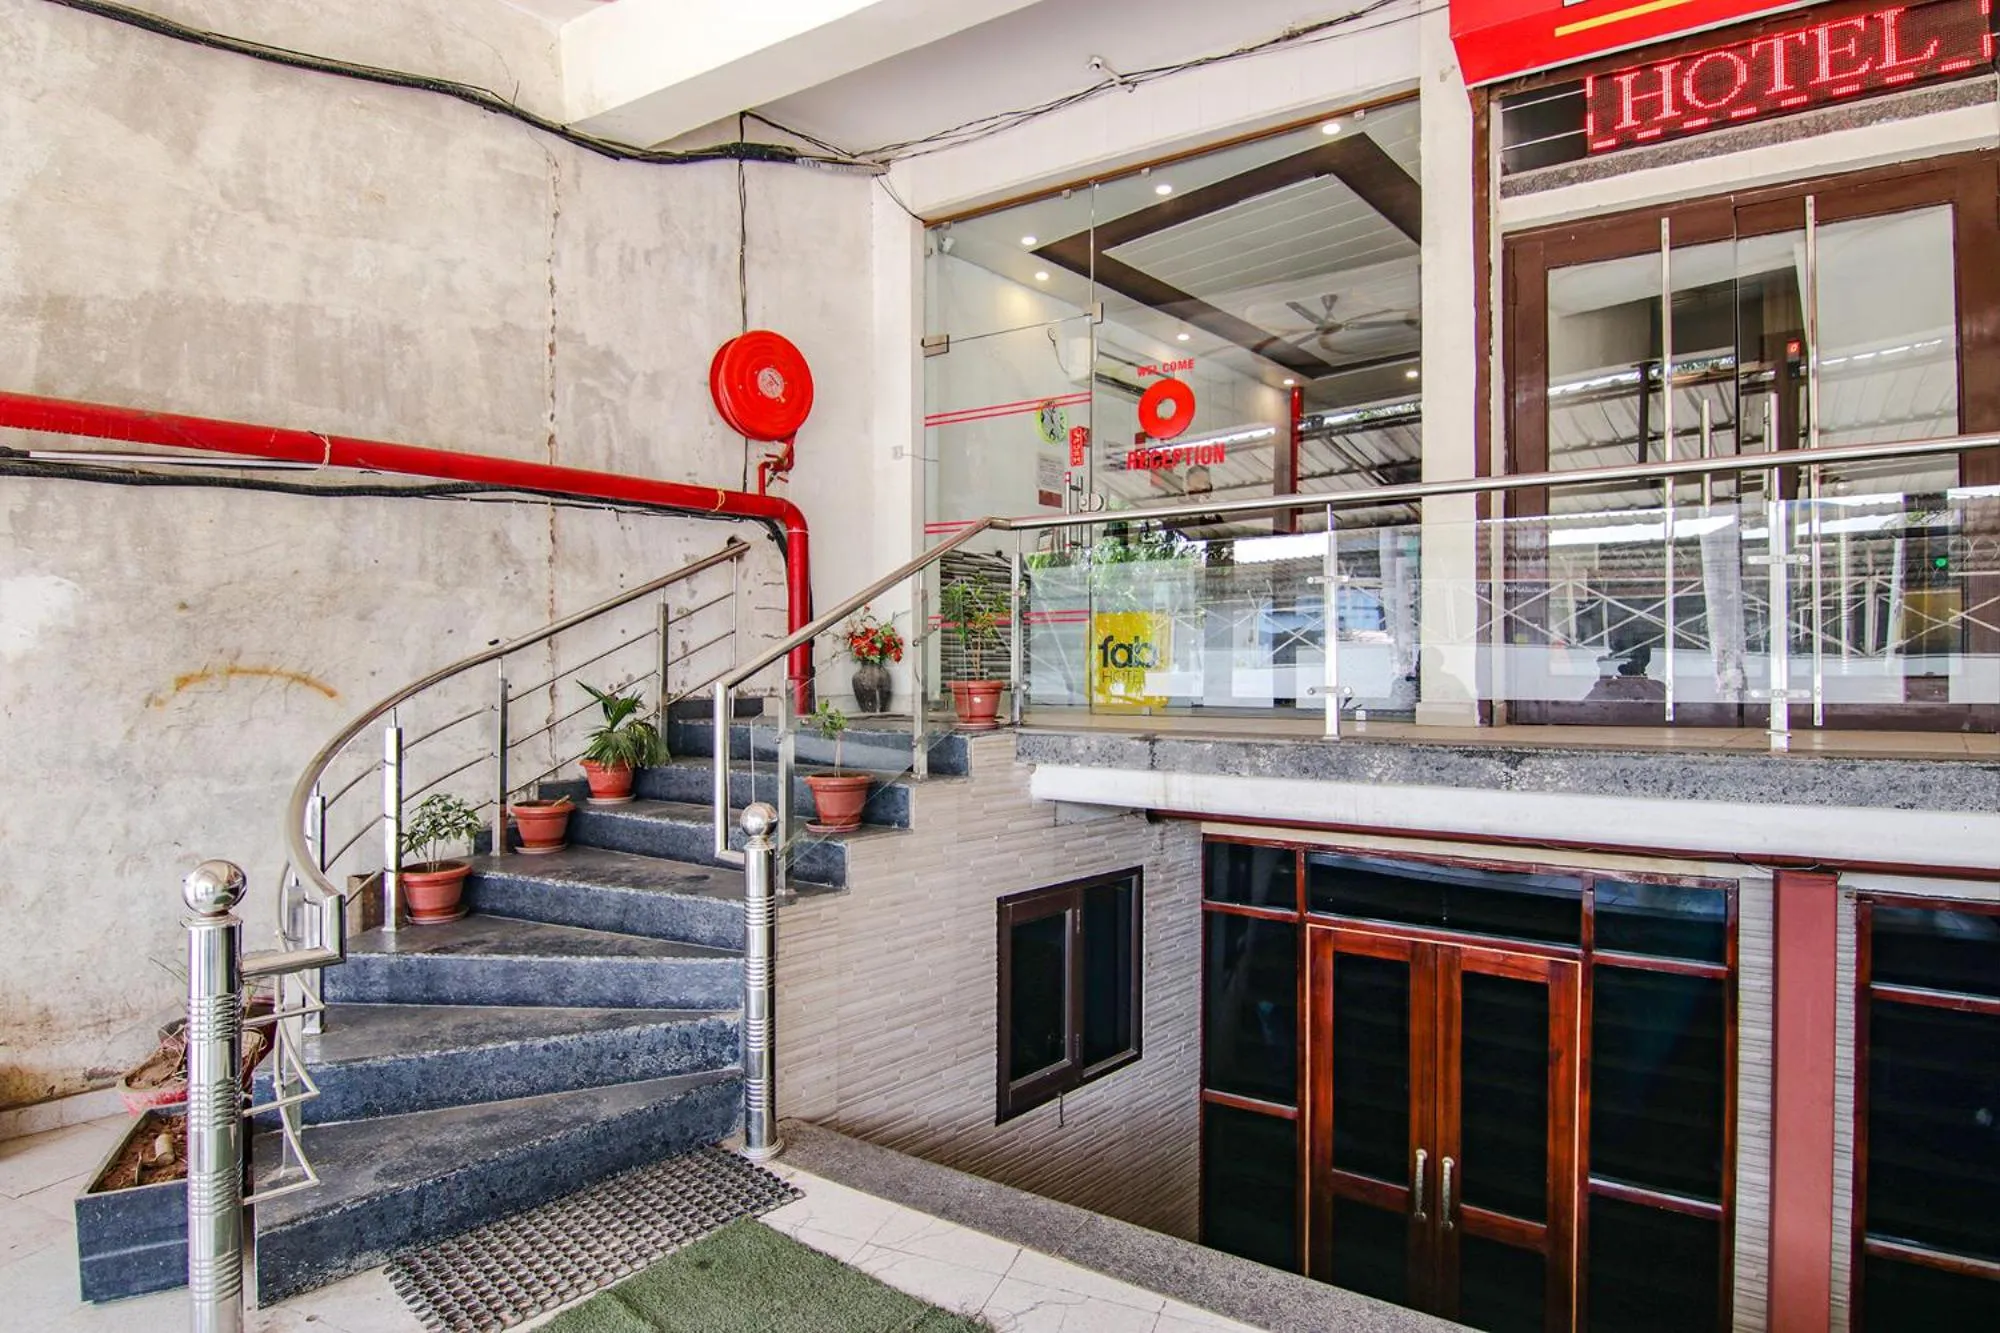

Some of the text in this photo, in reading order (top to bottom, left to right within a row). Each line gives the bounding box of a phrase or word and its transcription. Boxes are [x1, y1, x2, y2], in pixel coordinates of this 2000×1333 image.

[1614, 8, 1938, 130] HOTEL
[1126, 443, 1226, 471] RECEPTION
[1098, 635, 1158, 668] fab
